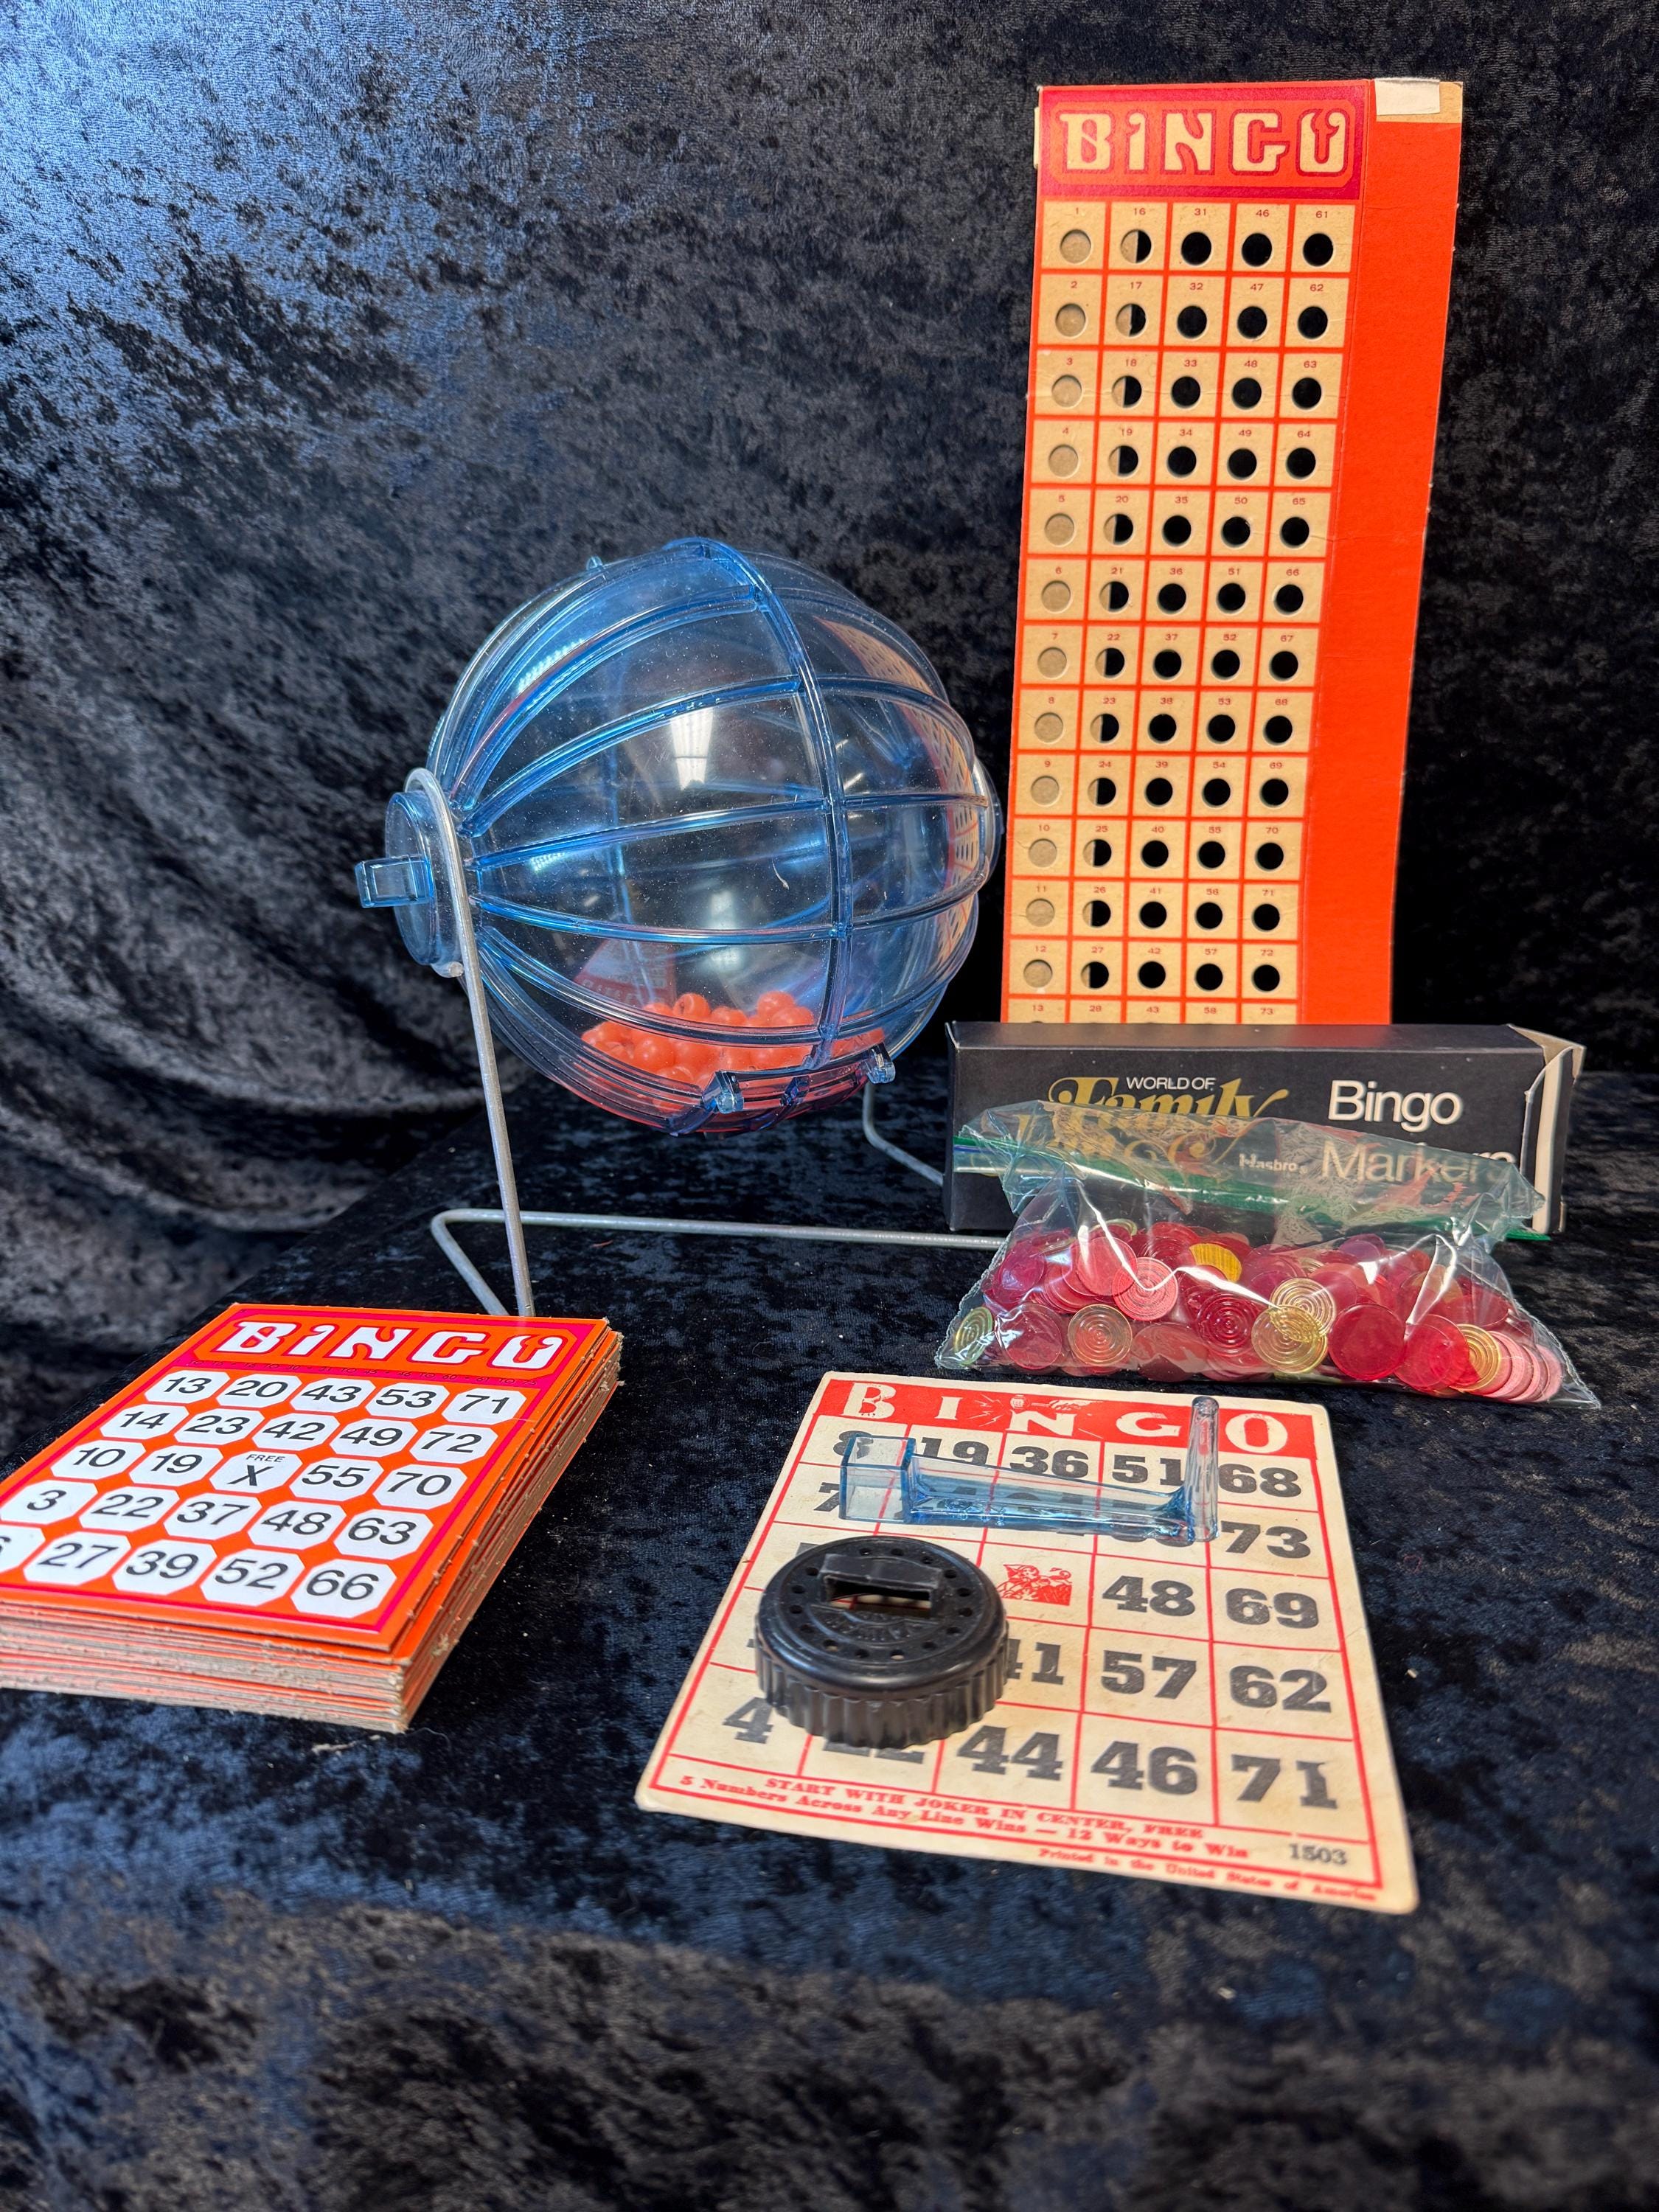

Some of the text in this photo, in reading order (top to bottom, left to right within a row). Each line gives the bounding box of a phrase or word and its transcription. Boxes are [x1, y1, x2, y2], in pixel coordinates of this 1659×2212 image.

[1060, 111, 1346, 173] BINGO
[1133, 207, 1147, 216] 16
[1194, 207, 1207, 216] 31
[1256, 209, 1270, 218] 46
[1315, 210, 1328, 219] 61
[1071, 280, 1324, 292] 2 17 32 47 62
[1066, 357, 1318, 369] 3 18 33 48 63
[1062, 426, 1311, 438] 4 19 34 49 64
[1058, 494, 1306, 506] 5 20 35 50 65
[1055, 566, 1300, 577] 6 21 36 51 66
[1051, 631, 1294, 642] 7 22 37 52 67
[1048, 696, 1289, 706] 8 23 38 53 68
[1099, 760, 1112, 768] 24
[1155, 760, 1169, 768] 39
[1212, 761, 1226, 769] 54
[1269, 762, 1284, 770] 69
[1038, 824, 1051, 832] 10
[1151, 825, 1165, 833] 40
[1208, 826, 1222, 834] 55
[1265, 826, 1279, 835] 70
[1036, 884, 1047, 893] 11
[1093, 886, 1107, 894] 26
[1206, 888, 1220, 896] 56
[1262, 888, 1275, 897] 71
[1035, 945, 1274, 956] 12 27 42 57 72
[1032, 1004, 1044, 1012] 13
[1146, 1006, 1161, 1014] 43
[1203, 1006, 1217, 1015] 58
[1260, 1007, 1274, 1015] 73
[1126, 1077, 1217, 1091] WORLD OF
[1328, 1079, 1462, 1133] Bingo
[217, 1320, 564, 1370] BINGO
[164, 1377, 509, 1414] 13 20 43 53 71
[120, 1411, 482, 1453] 14 23 42 49 72
[73, 1447, 452, 1496] 10 19 X 55 70
[246, 1453, 287, 1465] FREE
[922, 1436, 990, 1465] 19
[1009, 1444, 1091, 1479] 36
[1112, 1455, 1184, 1487] 51
[1218, 1462, 1302, 1498] 68
[27, 1489, 417, 1545] 3 22 37 48 63
[1222, 1520, 1310, 1559] 73
[39, 1543, 118, 1568] 27
[126, 1551, 199, 1579] 39
[215, 1559, 288, 1590] 52
[306, 1569, 379, 1601] 66
[1102, 1576, 1318, 1629] 48 69
[1102, 1650, 1196, 1699] 57
[1231, 1666, 1331, 1712] 62
[959, 1725, 1062, 1781] 44
[1093, 1741, 1197, 1795] 46
[1234, 1755, 1335, 1807] 71
[678, 1775, 695, 1787] 5
[700, 1778, 789, 1804] Numbers
[796, 1794, 863, 1815] Across
[872, 1804, 912, 1822] Any
[919, 1810, 966, 1826] Line
[975, 1818, 1028, 1835] Wins
[1066, 1827, 1093, 1841] 12
[1102, 1831, 1162, 1851] Ways
[1171, 1839, 1194, 1853] to
[1203, 1843, 1251, 1860] Win
[765, 1776, 1206, 1840] START WITH JOKER IN CENTER, FREE
[1289, 1843, 1349, 1866] 1503
[1037, 1846, 1377, 1902] Printed in the United States of America
